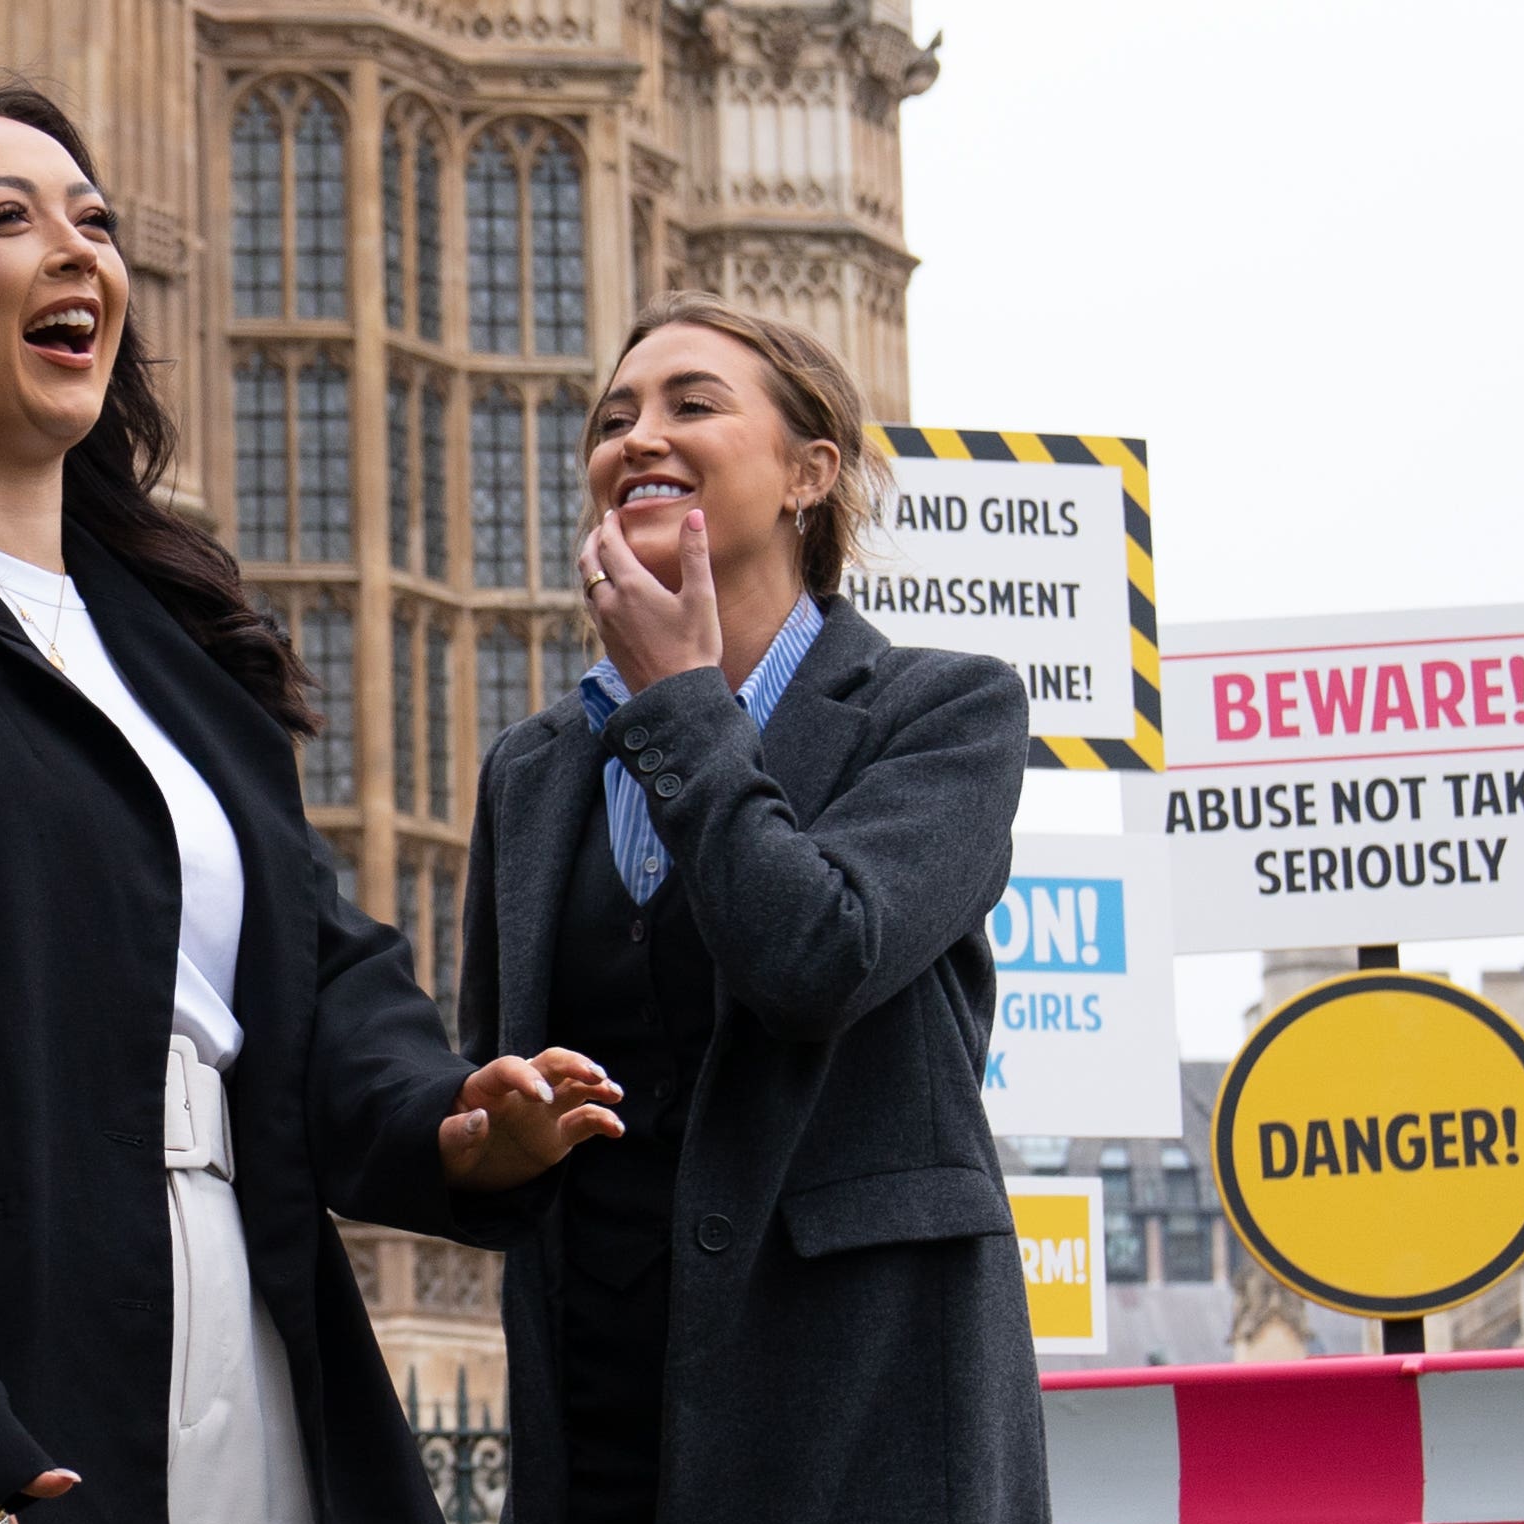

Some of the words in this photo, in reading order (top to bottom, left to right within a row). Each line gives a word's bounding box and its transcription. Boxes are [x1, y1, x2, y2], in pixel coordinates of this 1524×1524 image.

[896, 494, 968, 532] AND
[980, 497, 1079, 537] GIRLS
[848, 574, 1080, 618] HARASSMENT
[1164, 782, 1318, 835] ABUSE
[1330, 775, 1428, 826] NOT
[1253, 836, 1508, 897] SERIOUSLY
[1000, 991, 1103, 1033] GIRLS
[1257, 1105, 1521, 1181] DANGER!
